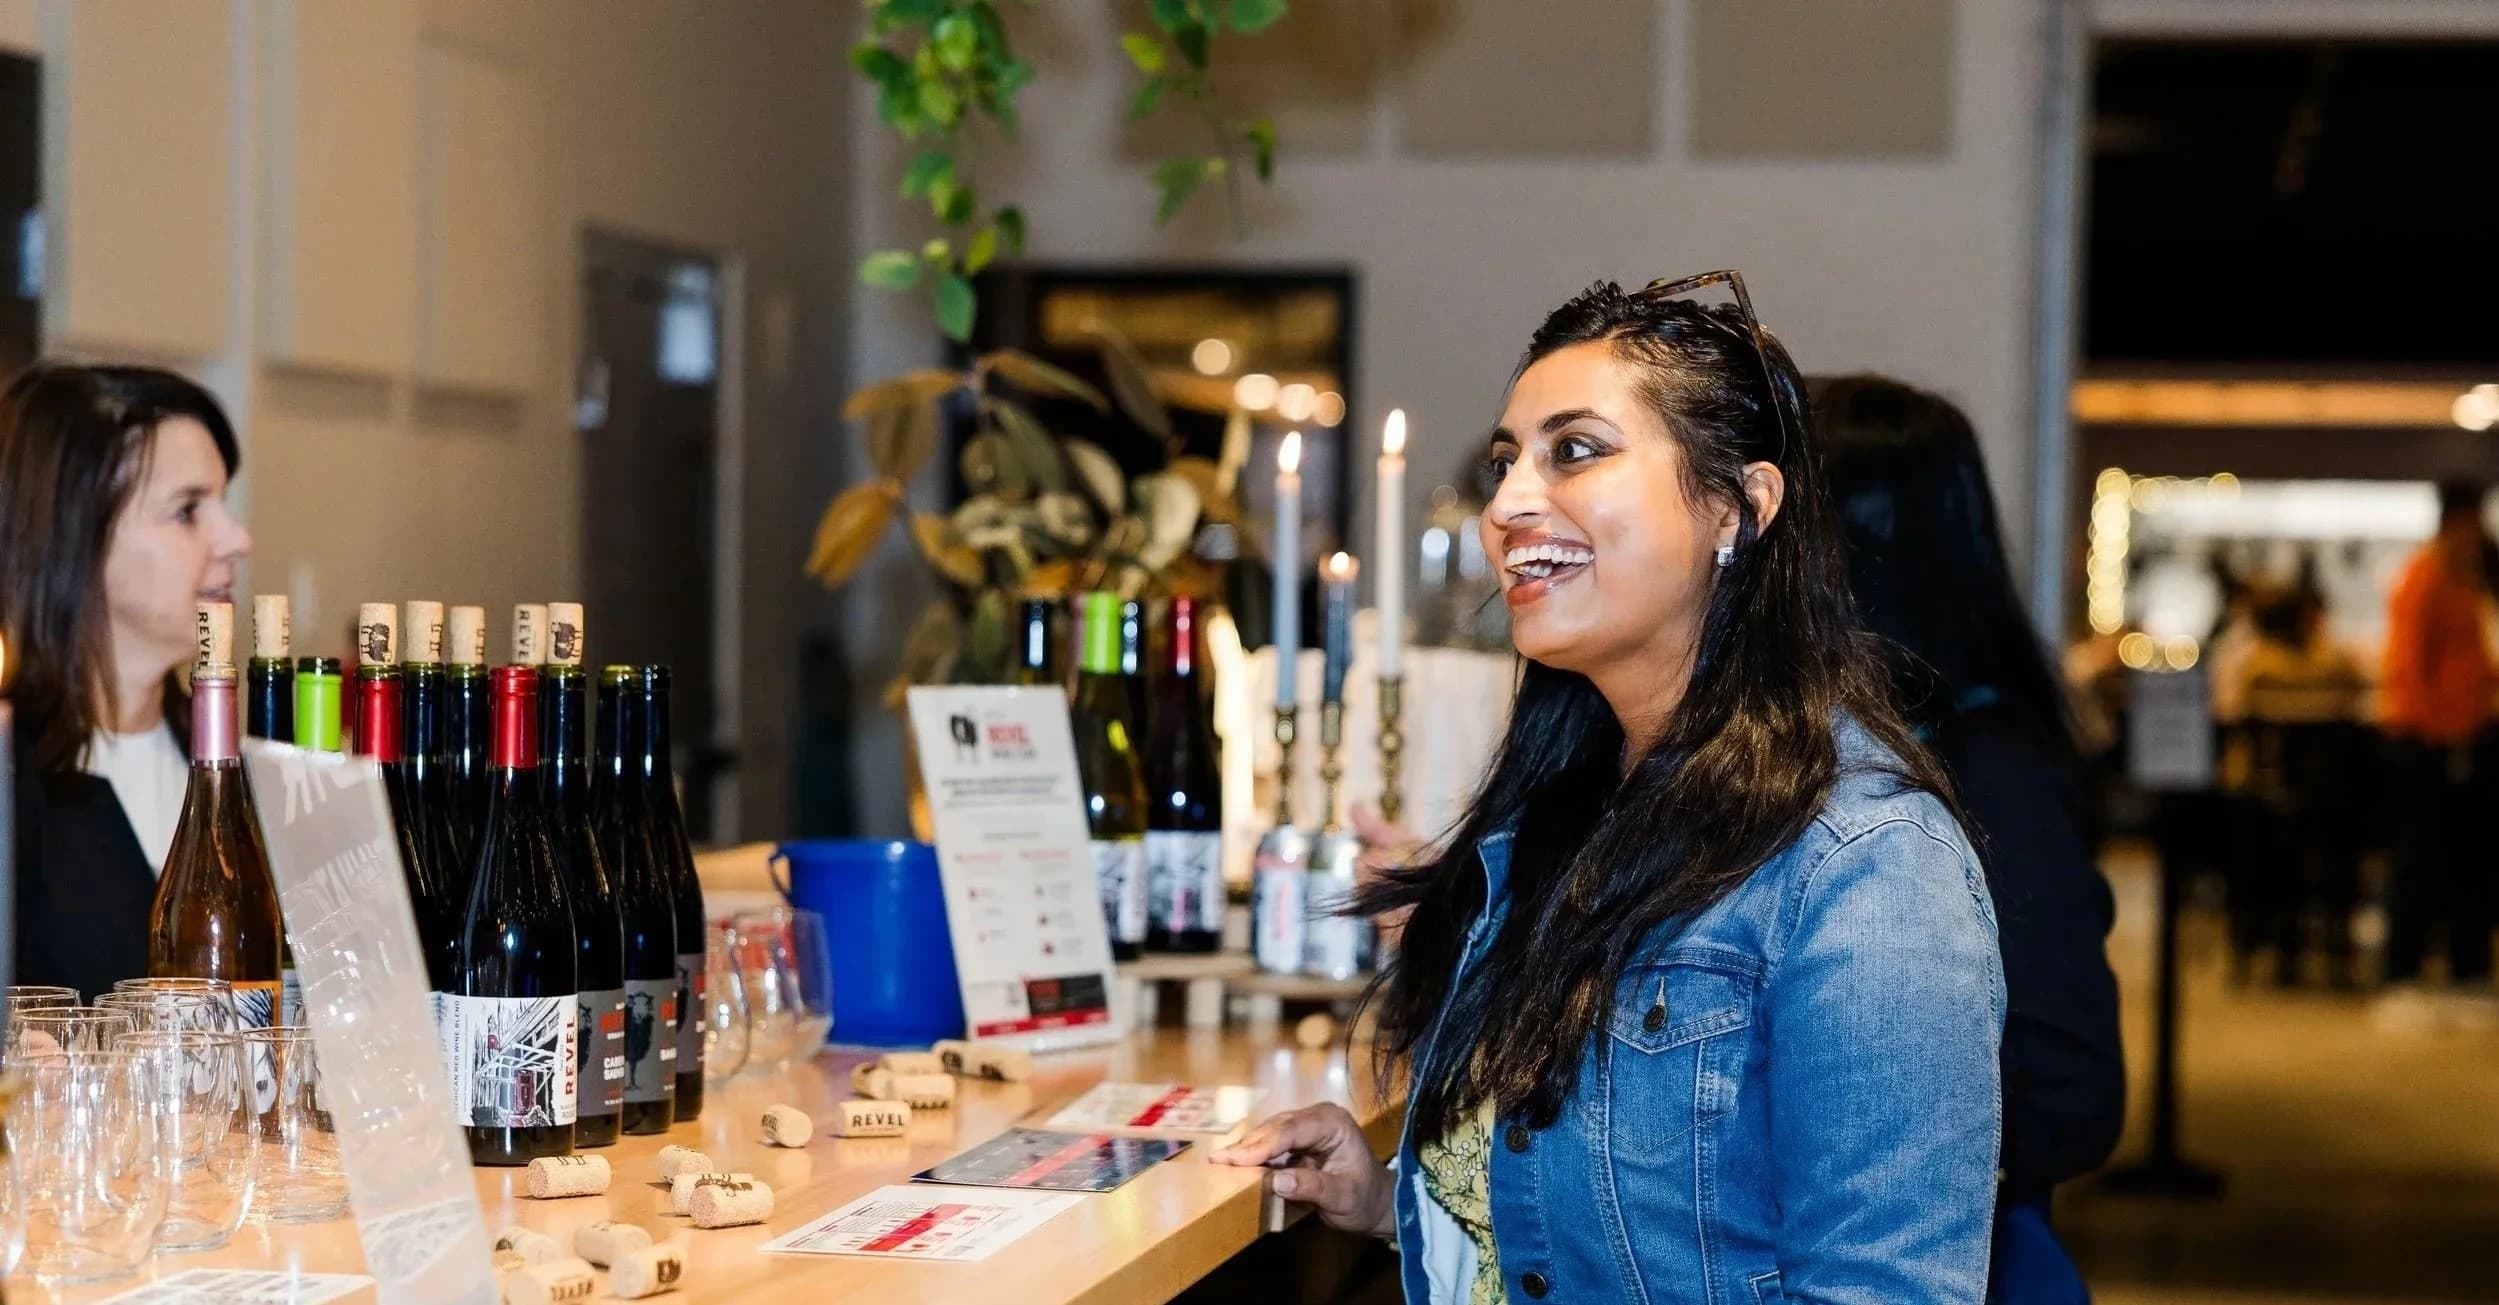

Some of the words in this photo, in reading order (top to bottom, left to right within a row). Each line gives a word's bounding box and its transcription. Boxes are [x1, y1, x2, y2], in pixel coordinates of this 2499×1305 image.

[198, 611, 211, 669] REVEL
[519, 610, 530, 659] REVE
[565, 1016, 576, 1095] REVEL
[852, 1113, 904, 1128] REVEL
